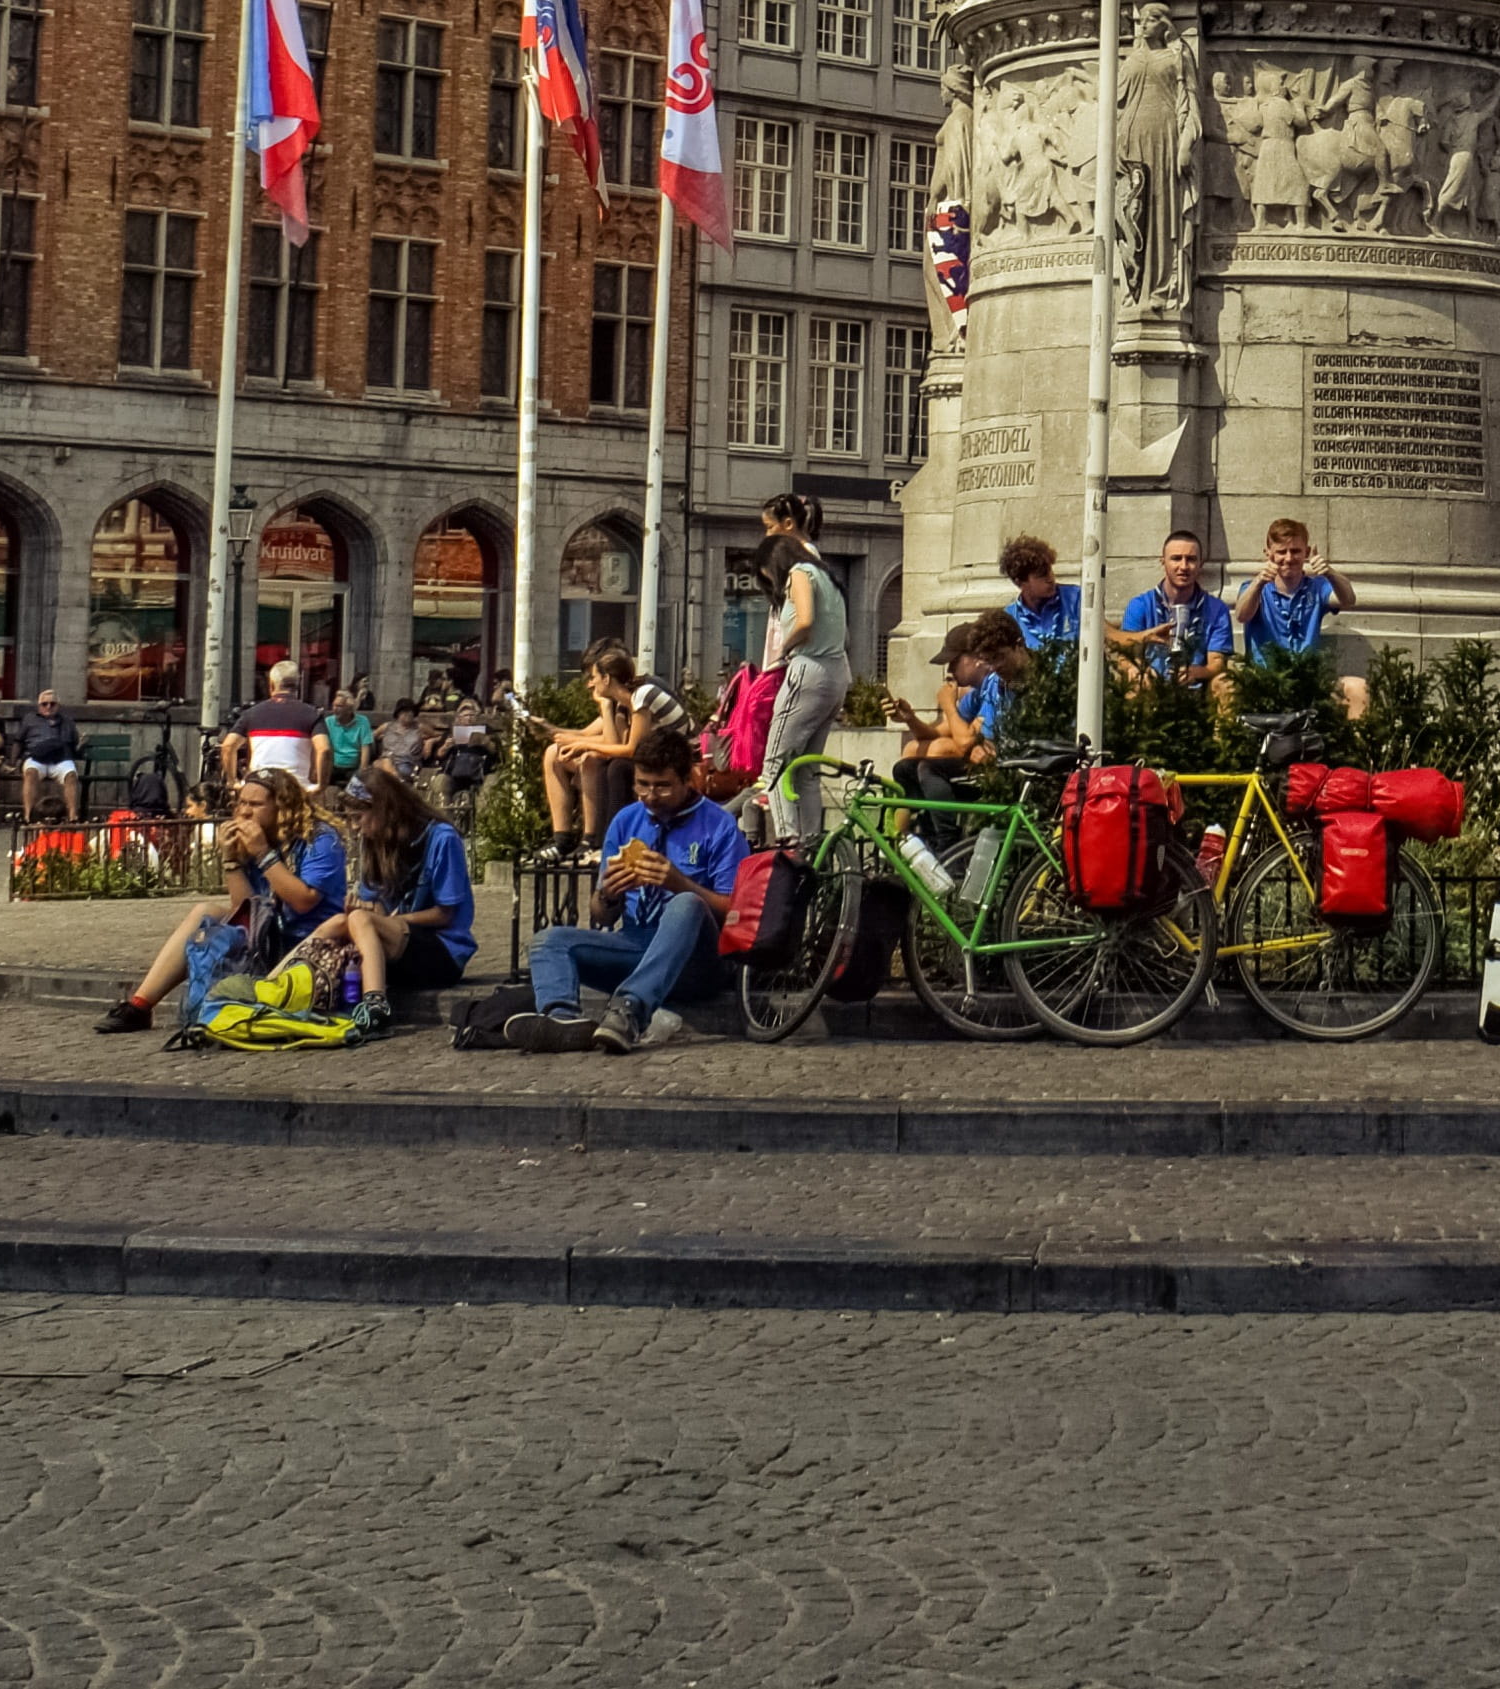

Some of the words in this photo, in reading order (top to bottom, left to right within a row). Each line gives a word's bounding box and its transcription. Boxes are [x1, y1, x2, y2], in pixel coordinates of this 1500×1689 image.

[1314, 372, 1329, 384] DE
[1314, 457, 1328, 470] DE
[1334, 475, 1347, 487] DE
[1352, 476, 1383, 488] STAD
[261, 541, 326, 561] Kruidvat
